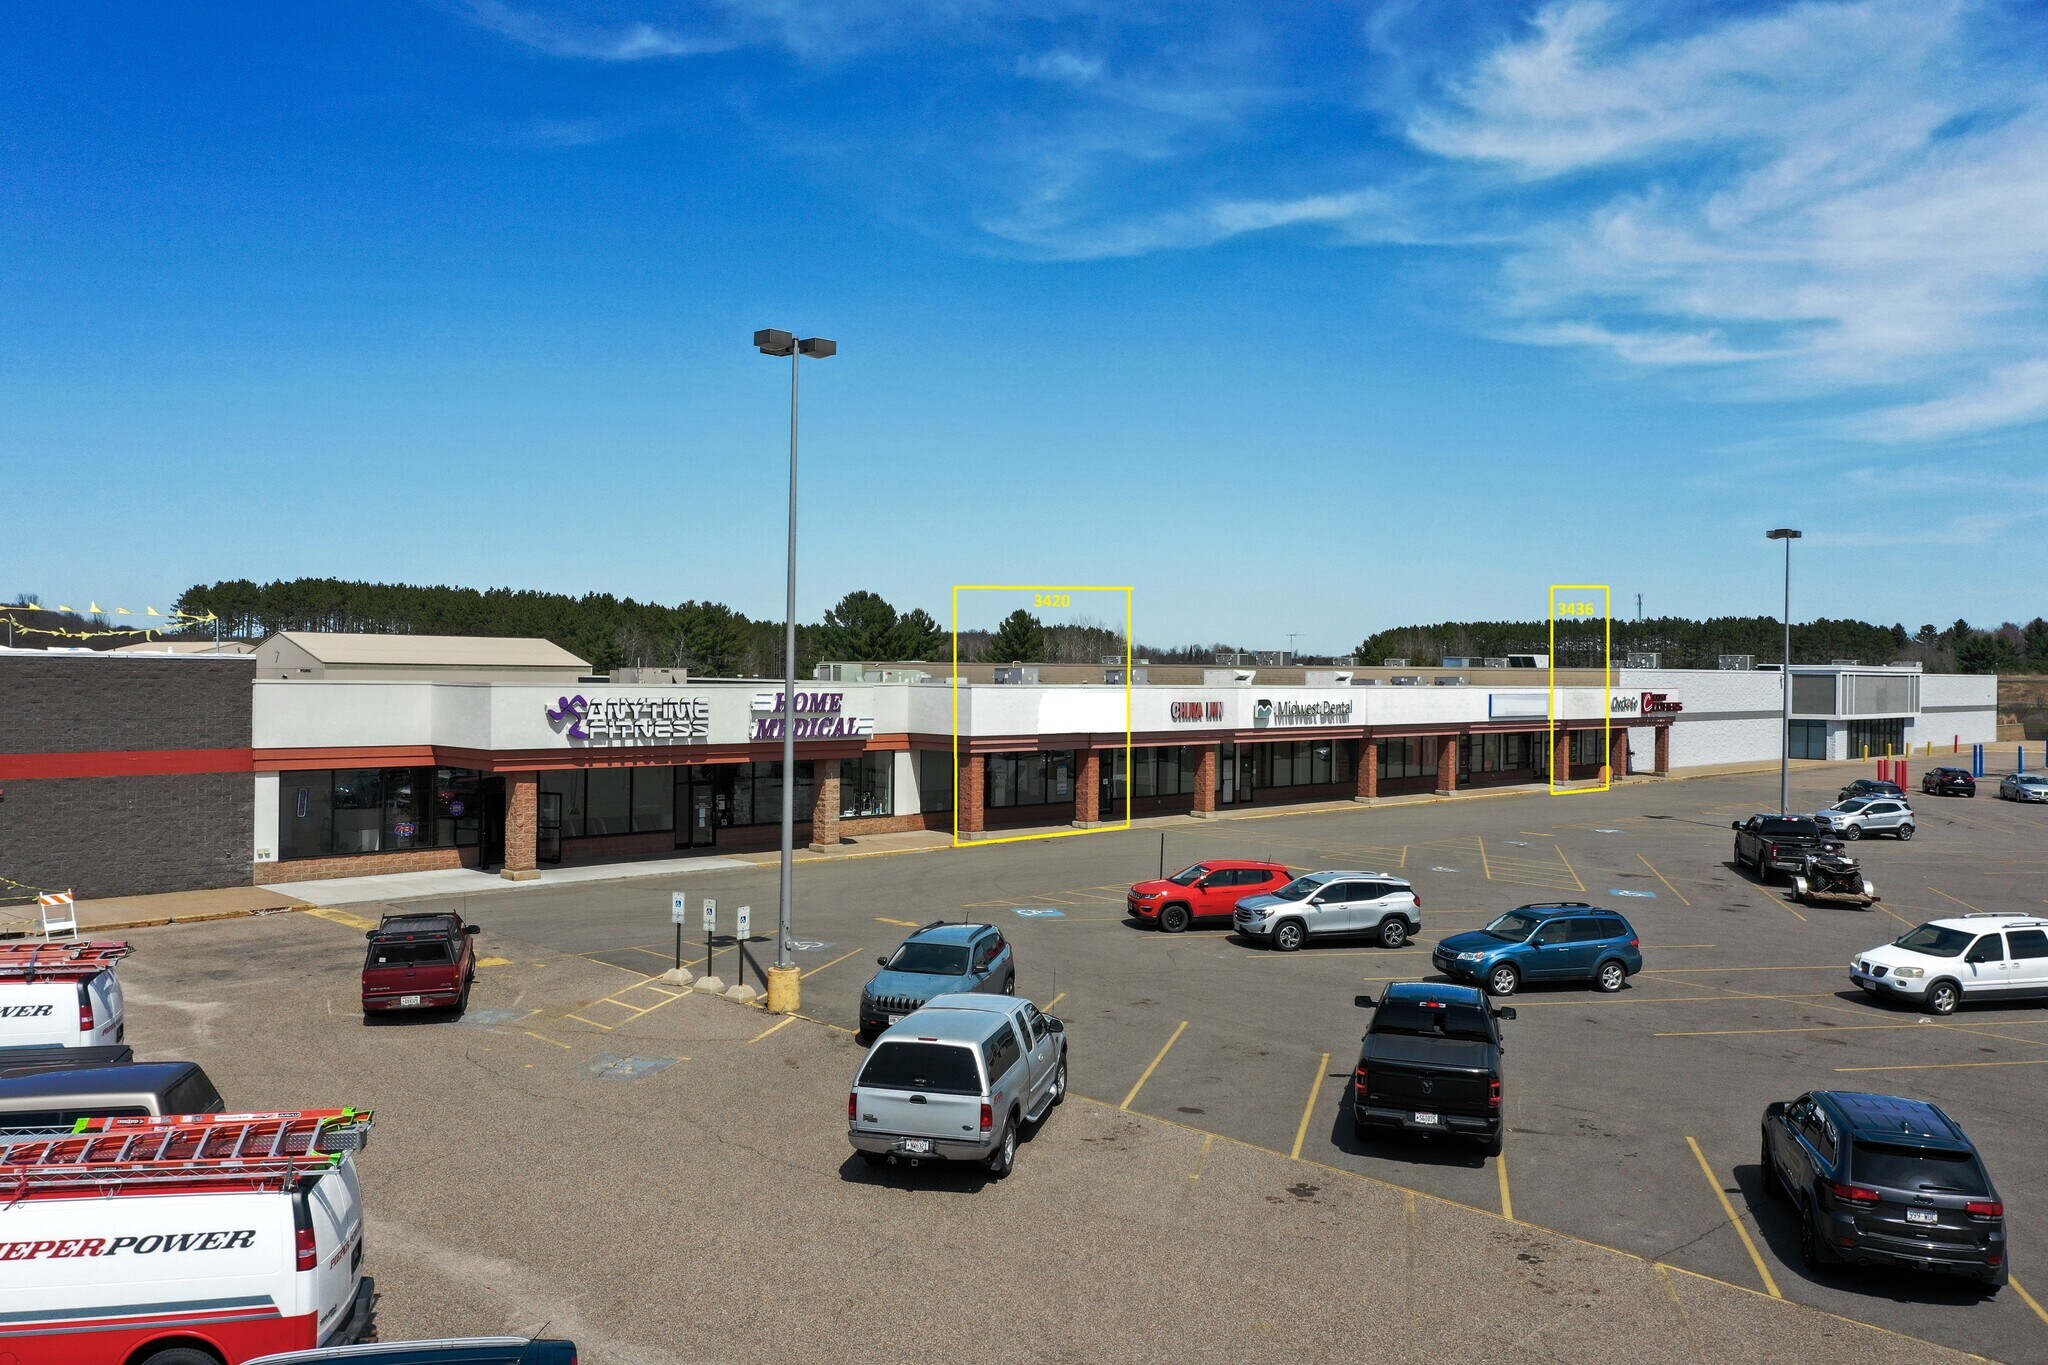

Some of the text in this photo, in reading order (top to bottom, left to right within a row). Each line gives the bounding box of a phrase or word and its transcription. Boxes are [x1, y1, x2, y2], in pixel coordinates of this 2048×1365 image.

[587, 697, 710, 720] ANYTIME
[1171, 701, 1224, 718] CHINA INN
[1278, 700, 1352, 716] Midwest Dental
[588, 719, 709, 739] FITNESS
